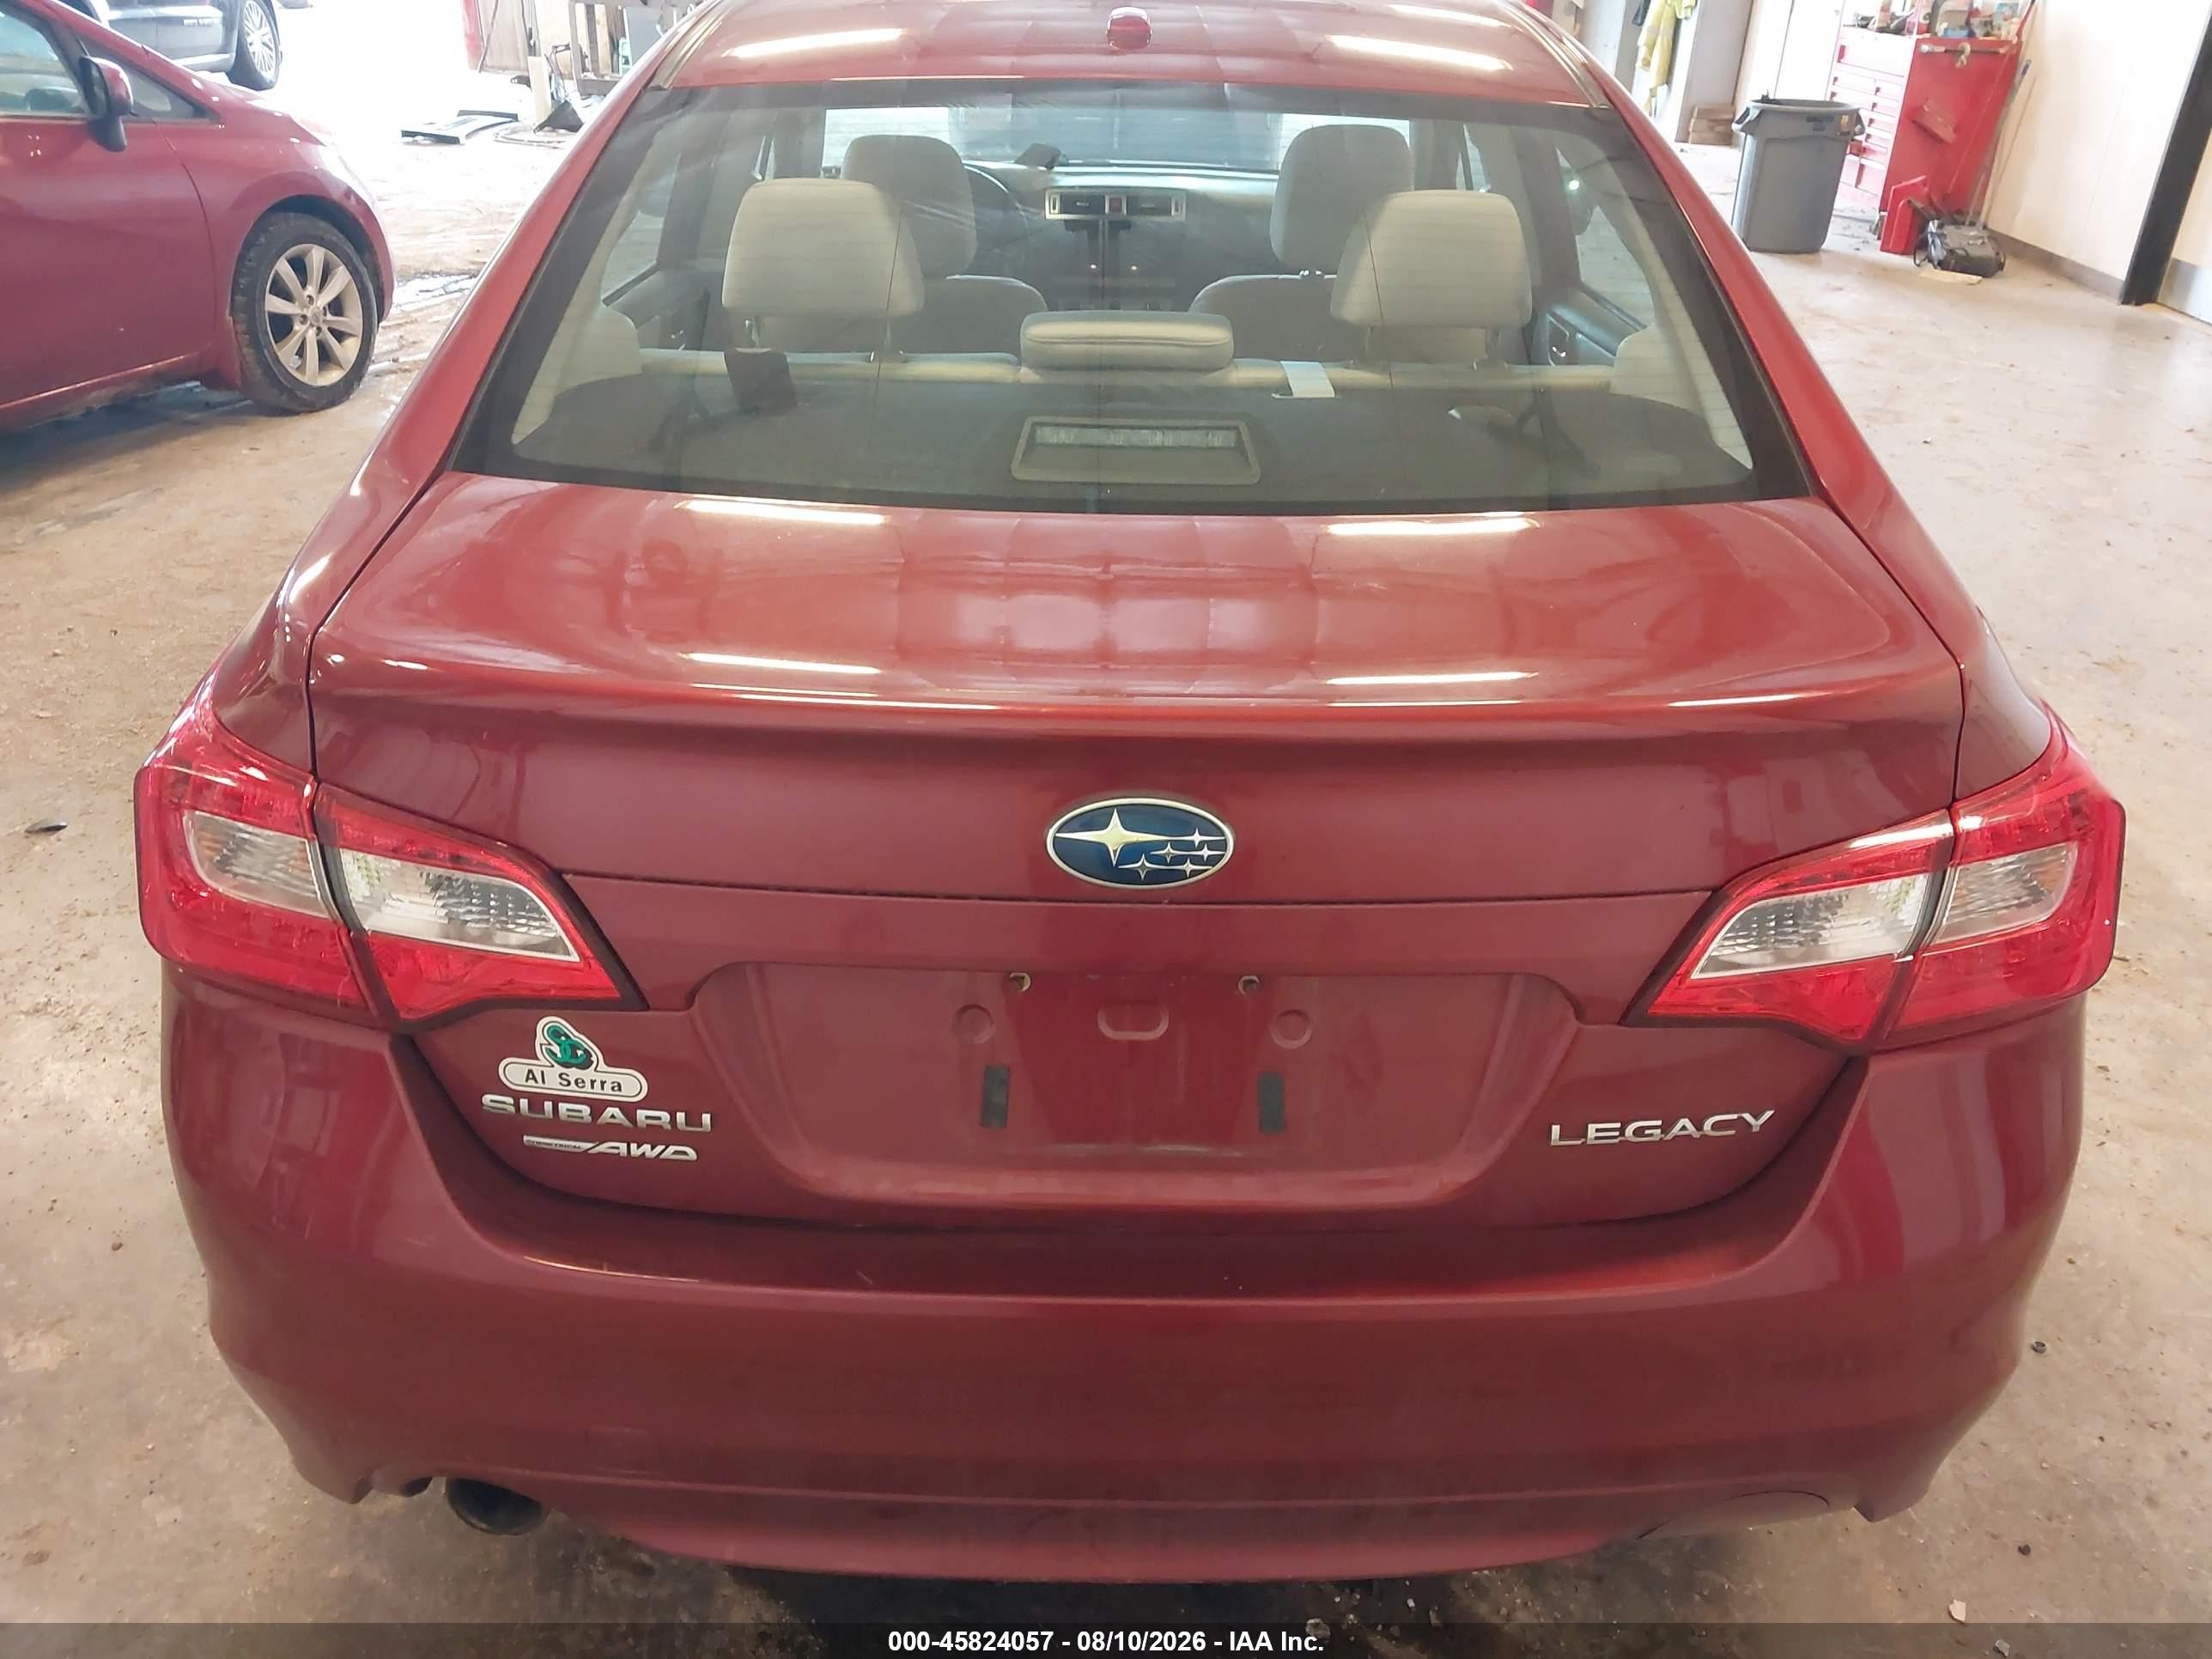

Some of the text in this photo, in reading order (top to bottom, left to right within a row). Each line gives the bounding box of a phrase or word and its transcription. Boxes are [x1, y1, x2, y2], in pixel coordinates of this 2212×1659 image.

[525, 1068, 623, 1092] Al Serra
[482, 1093, 712, 1133] SUBARU
[1550, 1109, 1775, 1146] LEGACY
[587, 1141, 697, 1161] AWD
